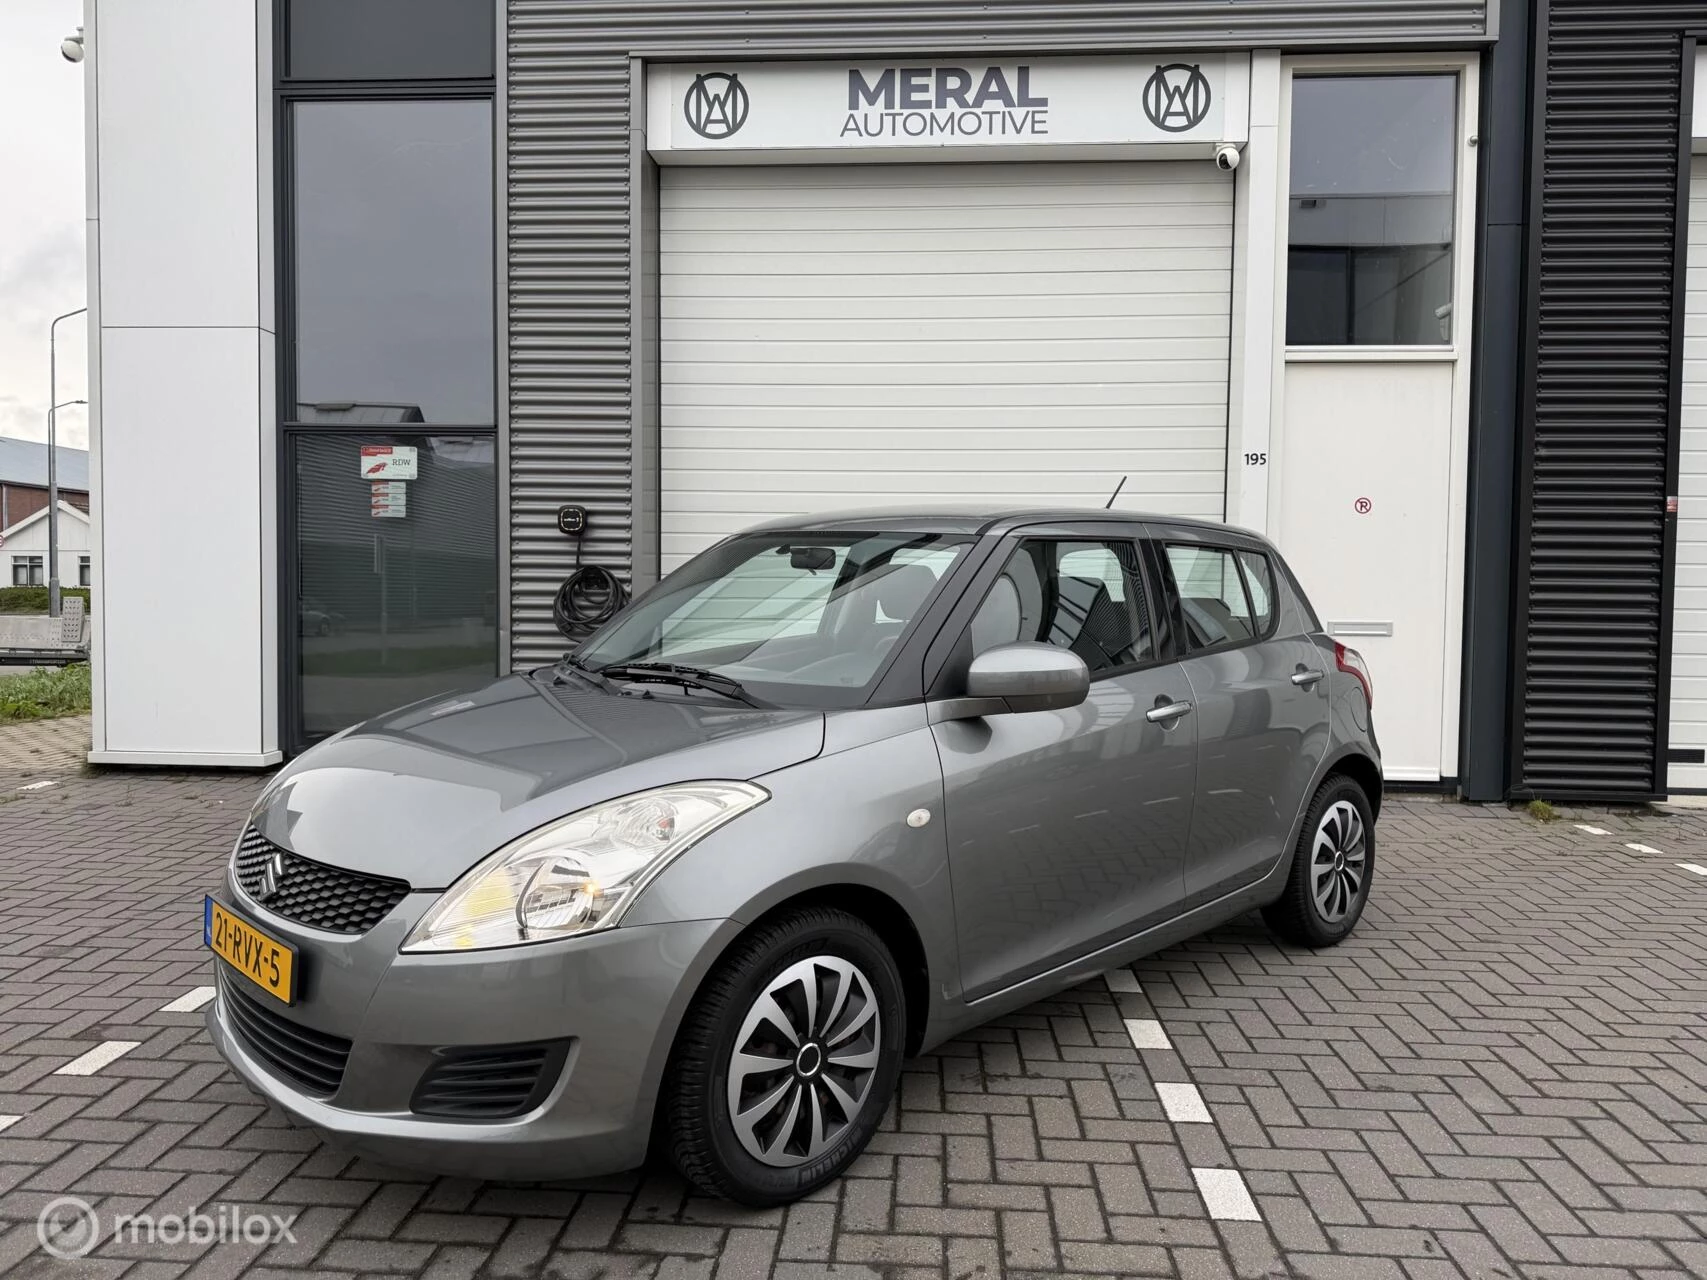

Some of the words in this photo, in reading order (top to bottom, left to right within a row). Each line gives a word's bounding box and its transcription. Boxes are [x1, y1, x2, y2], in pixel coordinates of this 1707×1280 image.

[847, 66, 1048, 110] MERAL
[840, 109, 1048, 137] AUTOMOTIVE
[1244, 453, 1267, 466] 195
[215, 912, 281, 988] 21-RVX-5
